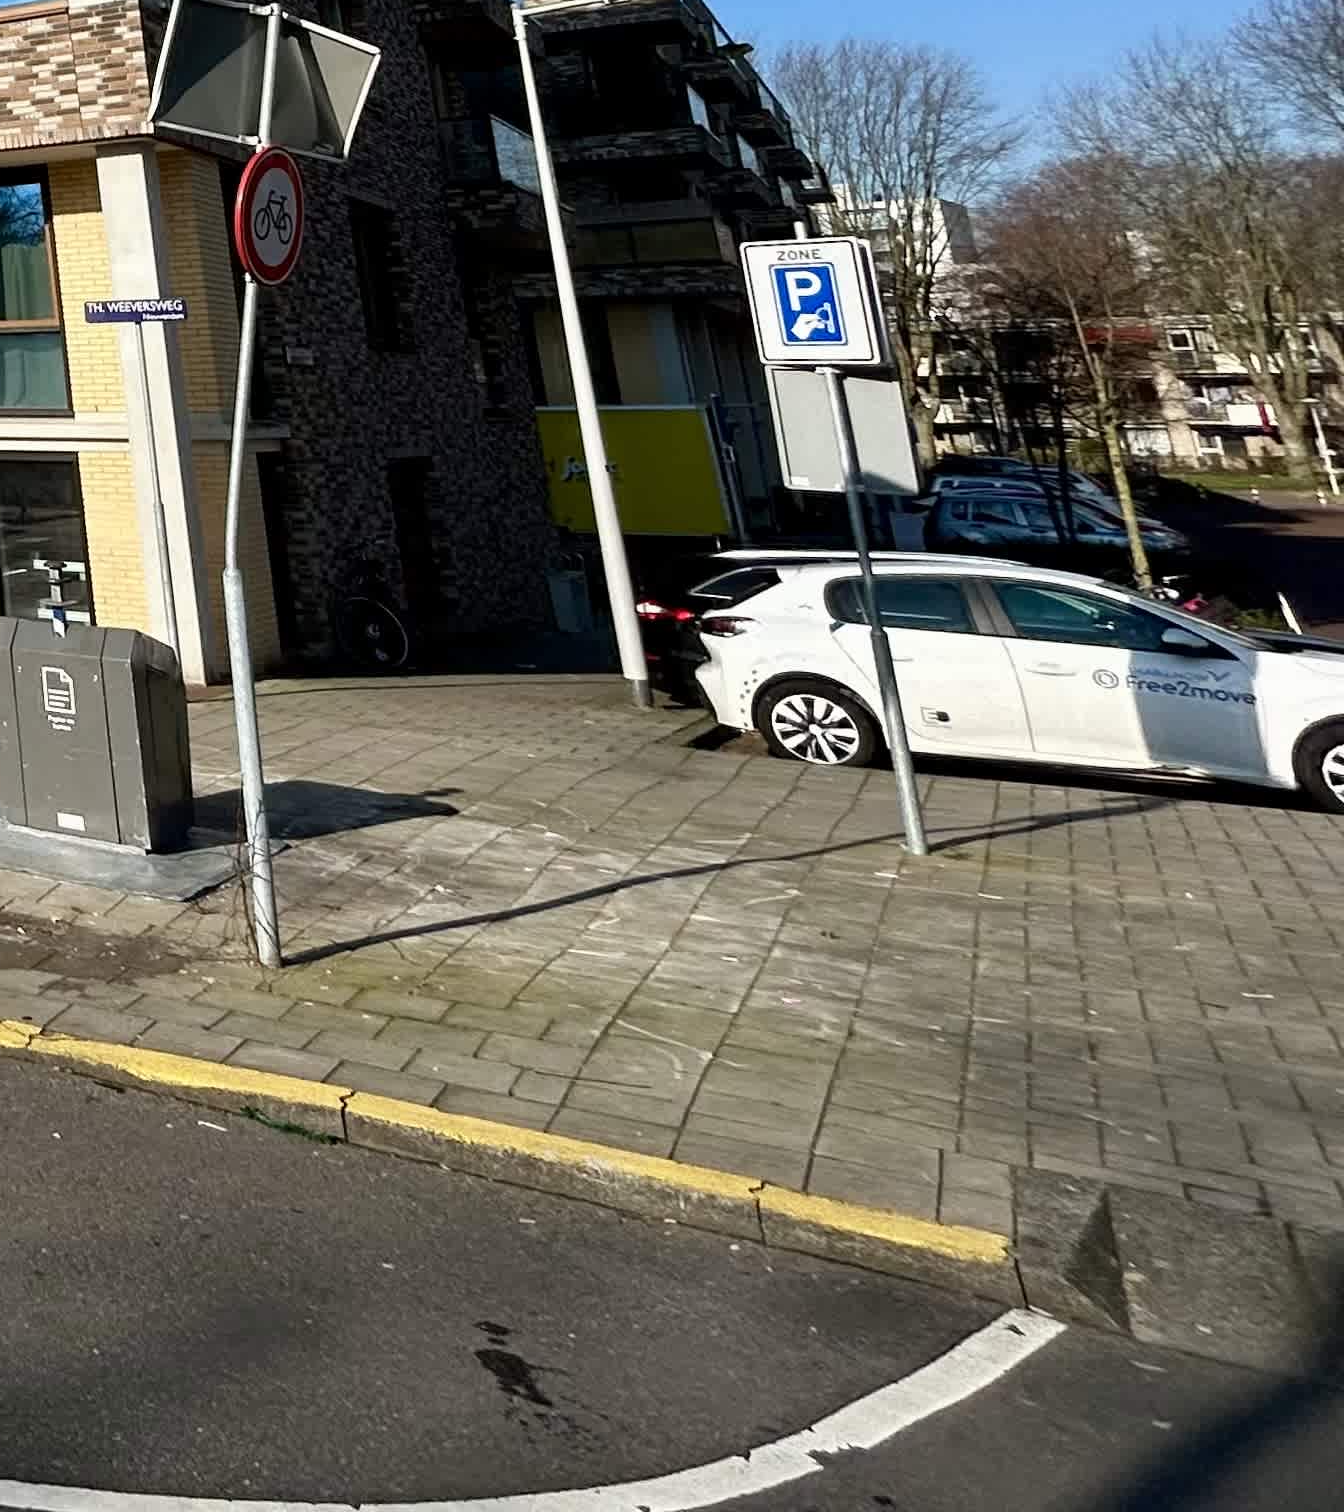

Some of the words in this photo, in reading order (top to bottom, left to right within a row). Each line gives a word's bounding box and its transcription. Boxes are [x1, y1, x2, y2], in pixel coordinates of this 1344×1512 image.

[776, 249, 822, 262] ZONE
[785, 270, 822, 312] P
[86, 302, 105, 313] TH.
[106, 300, 183, 313] WEEVERSWEG
[1126, 674, 1258, 706] Free2move
